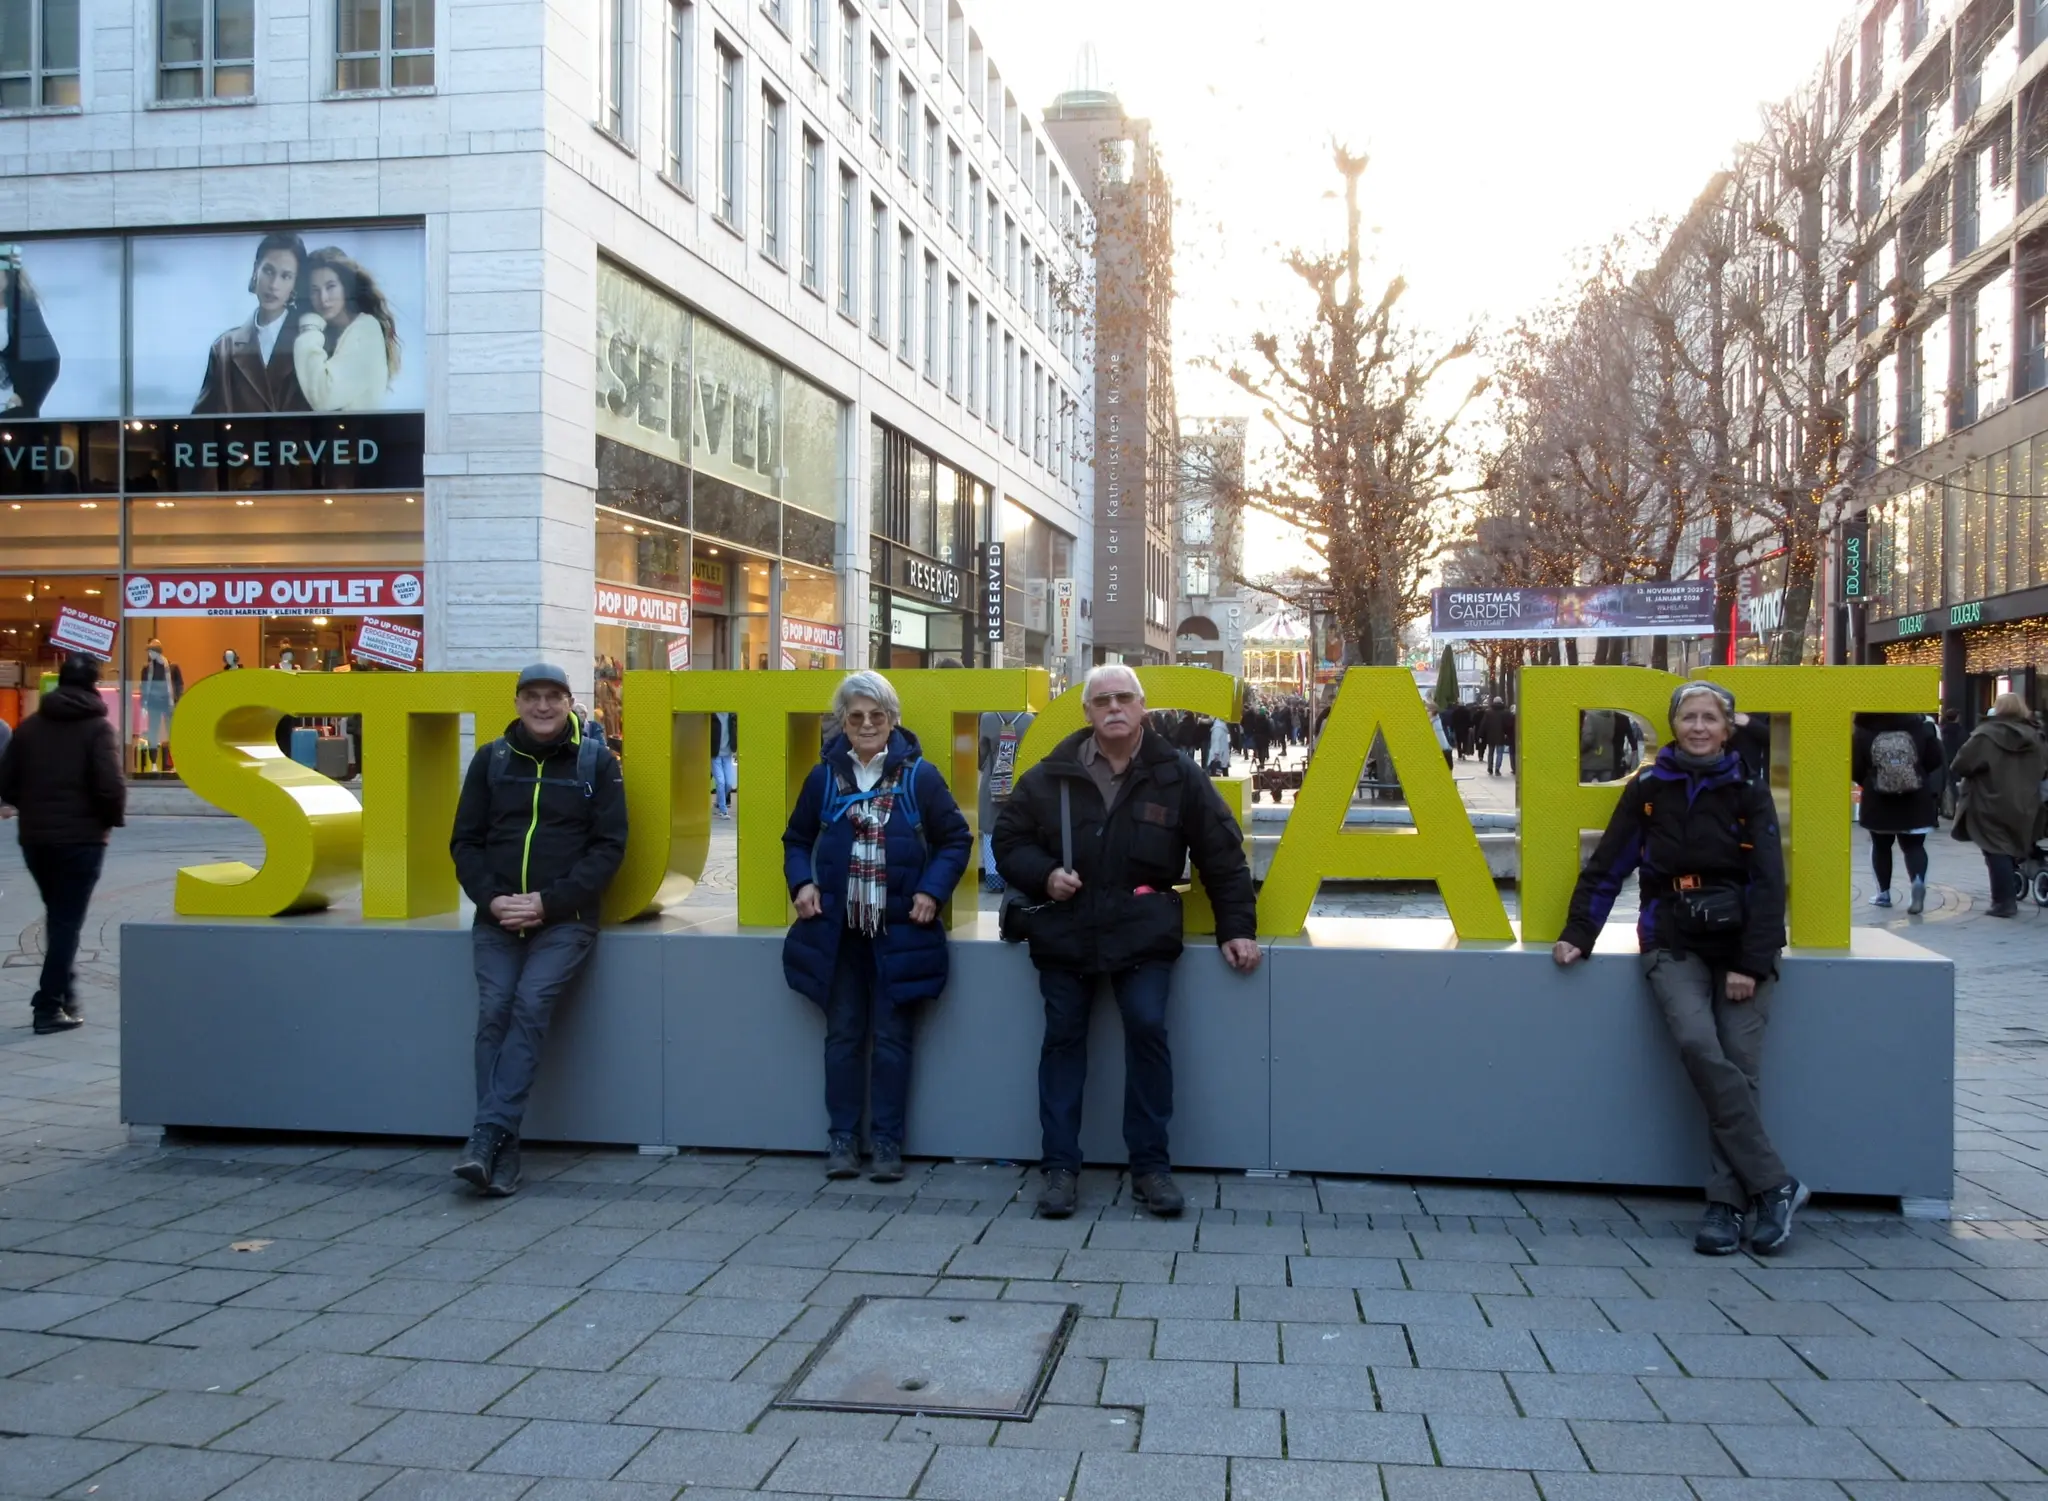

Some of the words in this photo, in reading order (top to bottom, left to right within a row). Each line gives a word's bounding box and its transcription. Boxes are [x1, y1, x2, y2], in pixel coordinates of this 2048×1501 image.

[3, 446, 75, 471] VED
[175, 439, 379, 467] RESERVED
[1107, 415, 1119, 517] Kathoischen
[1107, 529, 1118, 553] der
[1847, 538, 1859, 595] DOUGLAS
[159, 581, 217, 604] POP
[224, 581, 263, 604] UP
[271, 579, 384, 603] OUTLET
[910, 560, 960, 599] RESERVED
[989, 545, 1000, 639] RESERVED
[1107, 566, 1118, 601] Haus
[598, 590, 621, 614] POP
[623, 594, 638, 616] UP
[640, 597, 678, 622] OUTLET
[1449, 591, 1520, 604] CHRISTMAS
[62, 606, 78, 615] POP
[77, 611, 88, 619] UP
[89, 615, 117, 629] OUTLET
[1449, 602, 1521, 619] GARDEN
[1464, 619, 1505, 627] STUTTGART
[1951, 602, 1980, 625] DOUGLAS
[363, 616, 379, 626] POP
[380, 621, 392, 629] UP
[392, 625, 422, 638] OUTLET
[790, 622, 803, 640] POP
[803, 625, 813, 642] UP
[813, 627, 837, 646] OUTLET
[1059, 597, 1070, 653] Müller
[1227, 607, 1241, 652] ONLY
[1899, 616, 1922, 635] DOUGLAS
